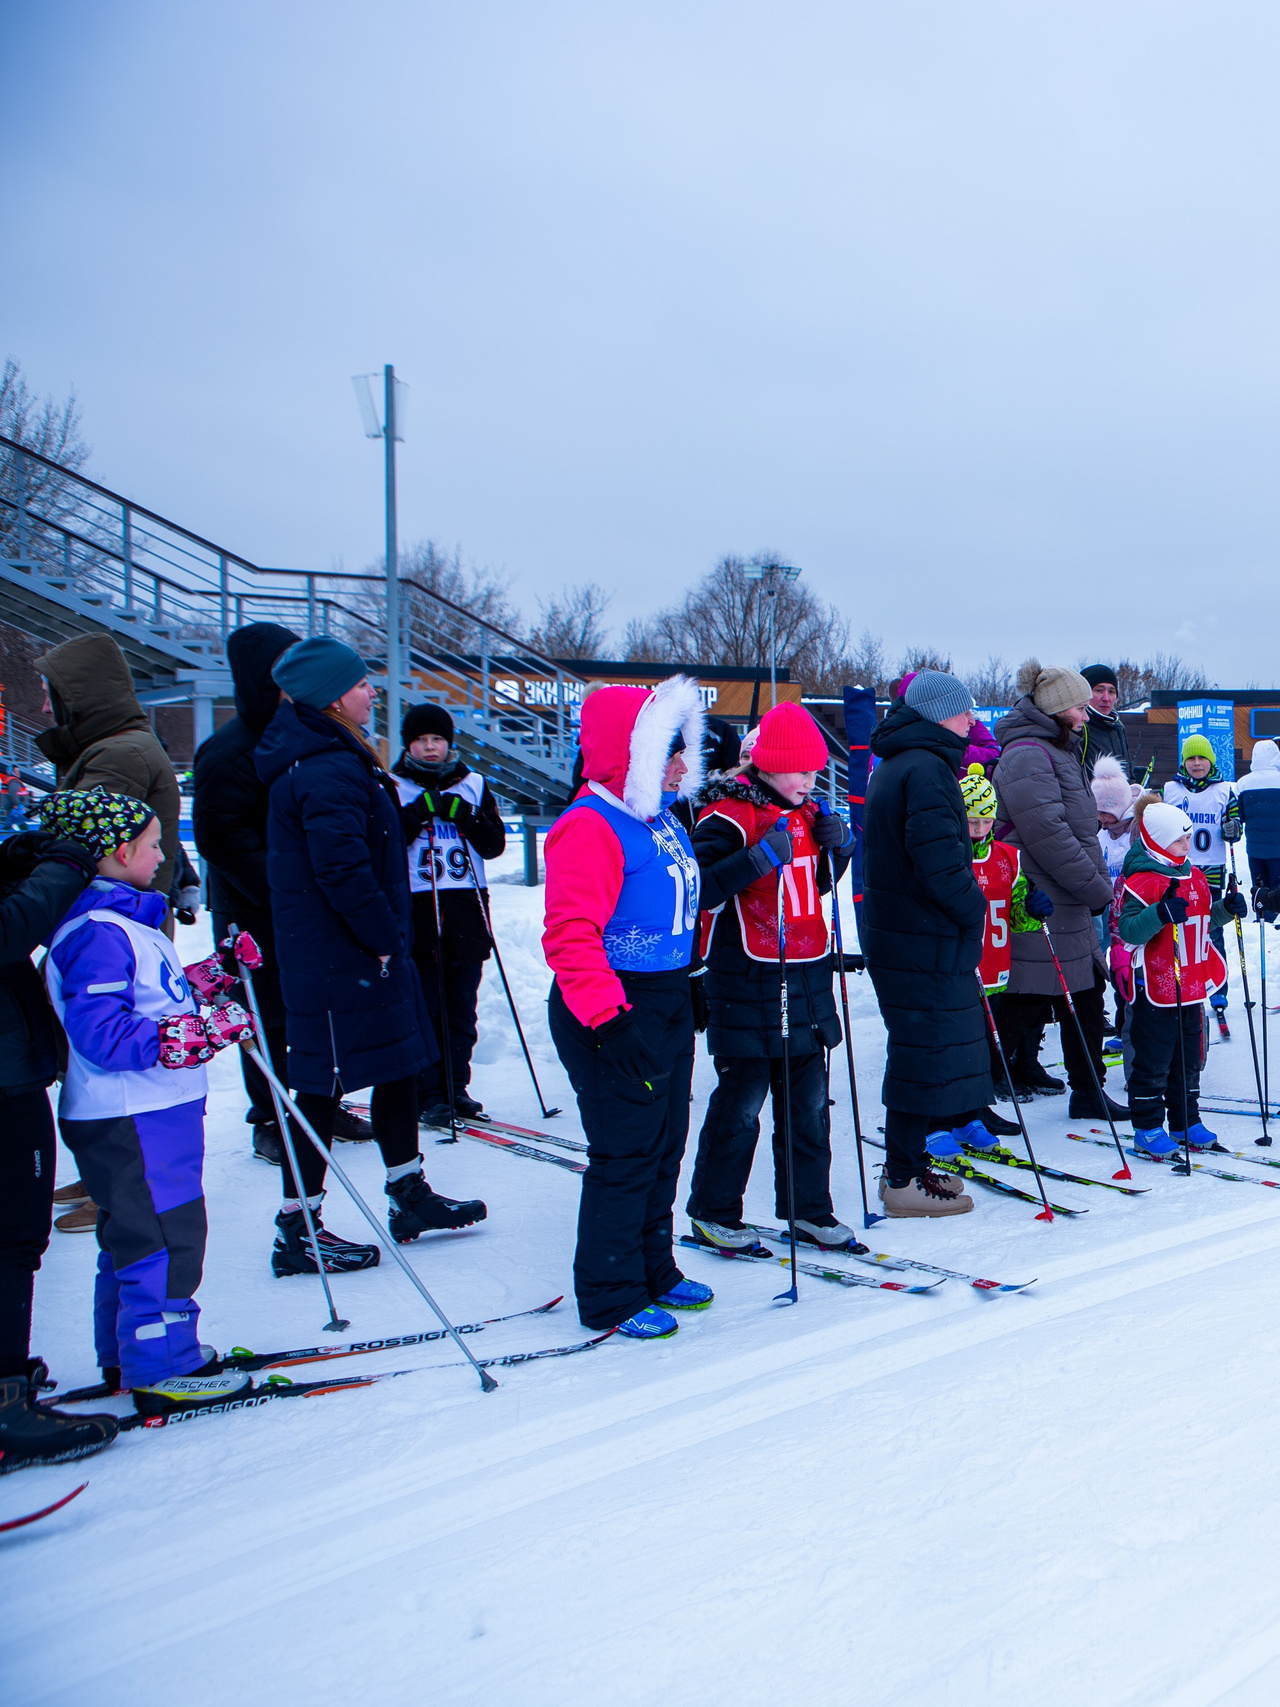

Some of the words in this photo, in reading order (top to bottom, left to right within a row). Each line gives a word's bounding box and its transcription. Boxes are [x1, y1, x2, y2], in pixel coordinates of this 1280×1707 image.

[1179, 705, 1203, 719] ФИНИШ
[417, 845, 469, 882] 59
[163, 1380, 230, 1390] FISCHER
